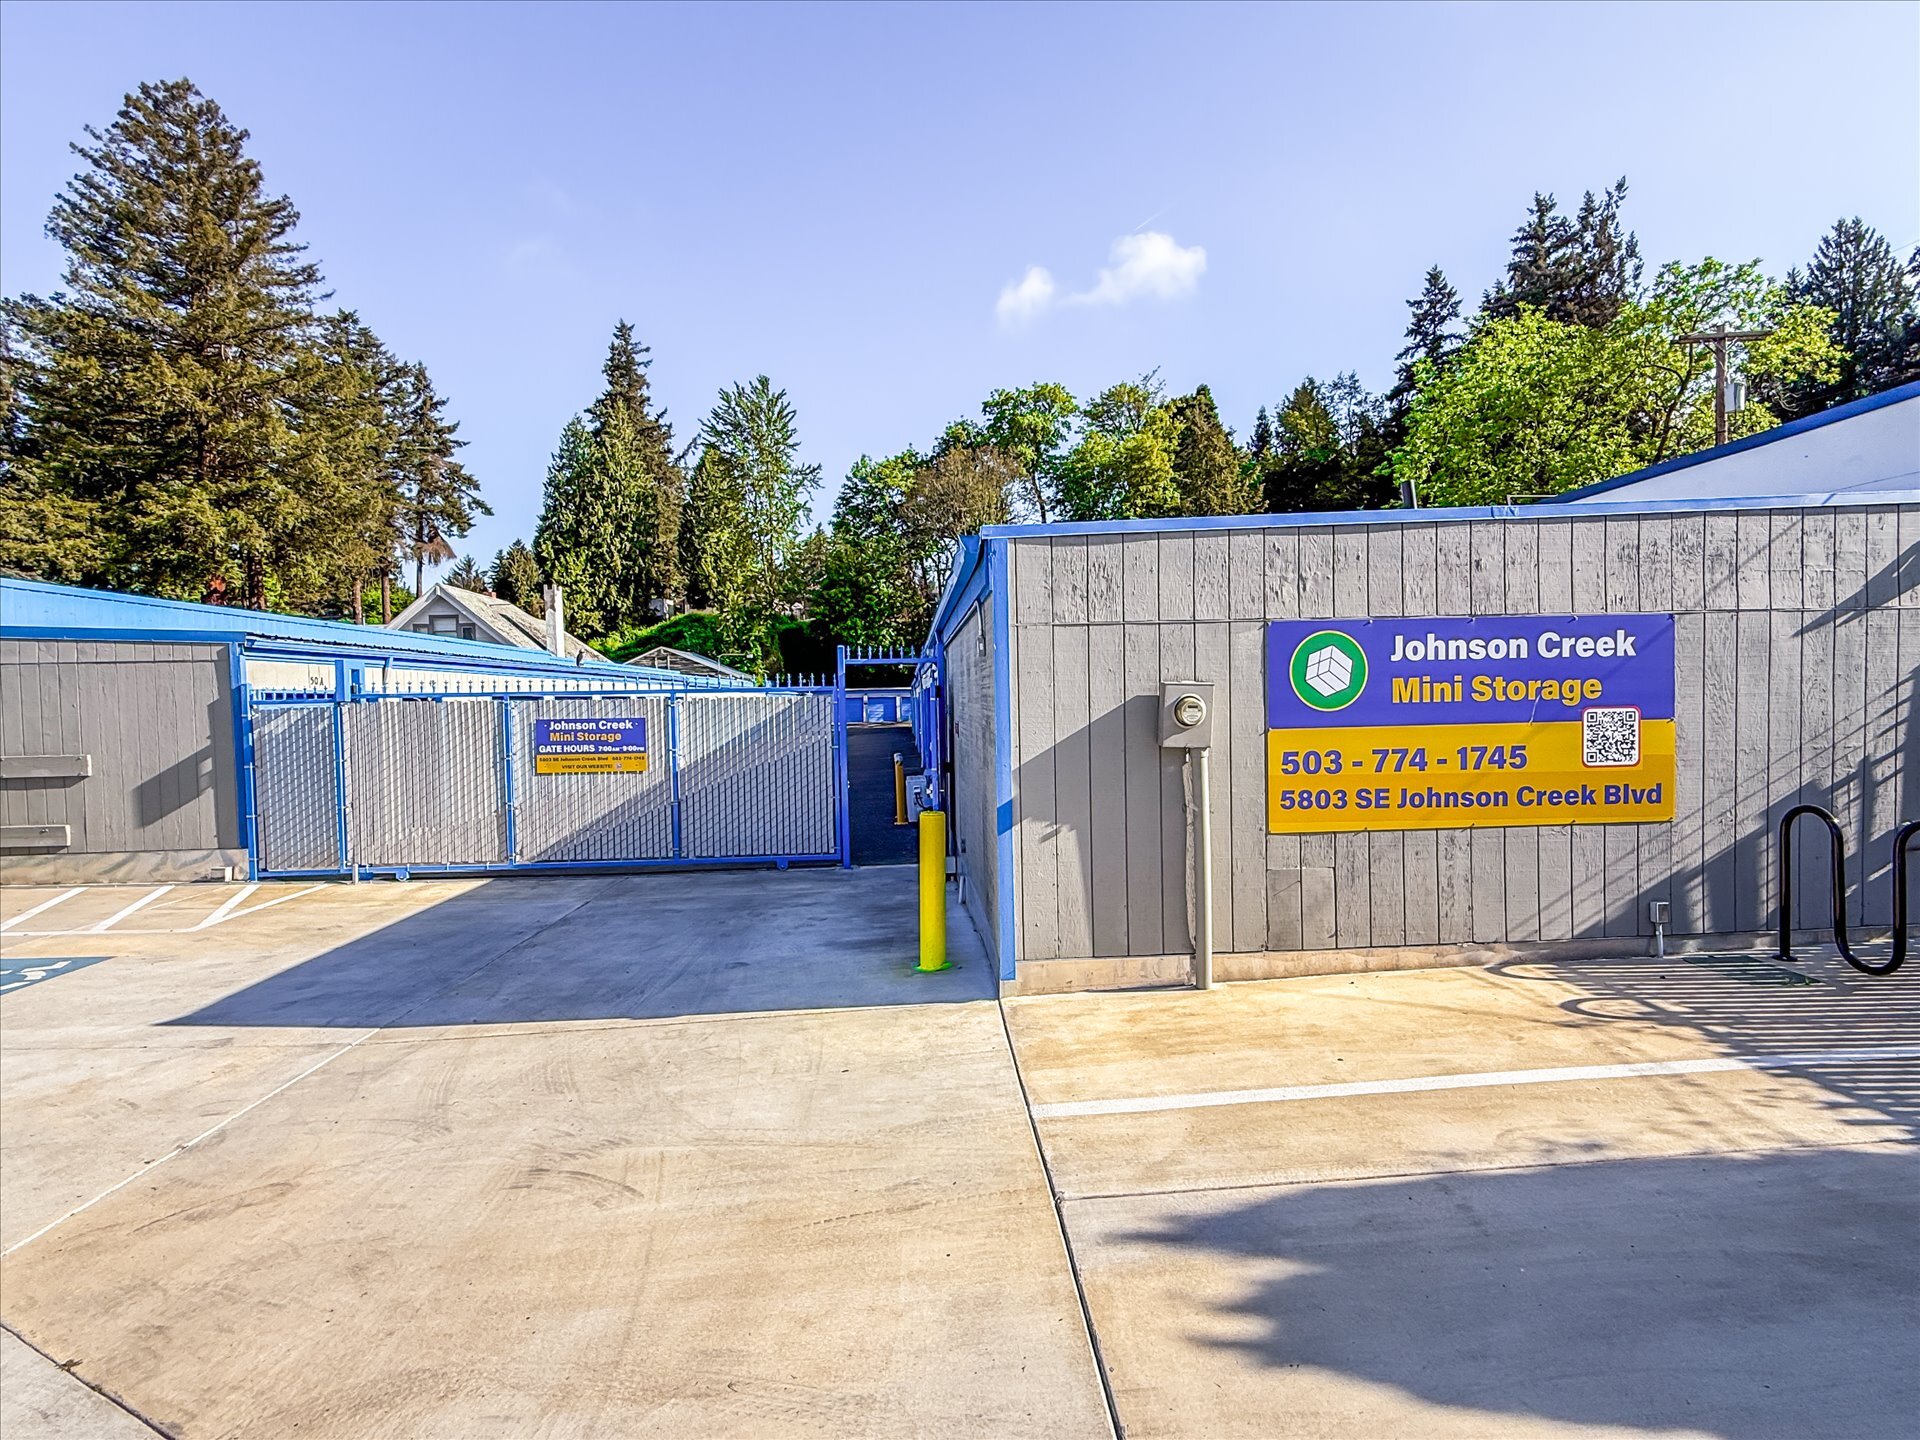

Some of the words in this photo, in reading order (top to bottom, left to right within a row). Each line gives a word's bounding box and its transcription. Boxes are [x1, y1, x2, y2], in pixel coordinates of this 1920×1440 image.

[1391, 633, 1528, 662] Johnson
[1537, 629, 1637, 658] Creek
[1392, 675, 1463, 704] Mini
[1471, 673, 1603, 706] Storage
[549, 721, 596, 730] Johnson
[599, 720, 633, 729] Creek
[550, 732, 574, 741] Mini
[577, 732, 622, 743] Storage
[539, 745, 562, 753] GATE
[1281, 750, 1343, 775] 503
[1371, 748, 1428, 773] 774
[1456, 744, 1528, 771] 1745
[1280, 788, 1348, 810] 5803
[1355, 787, 1391, 809] SE
[1397, 786, 1509, 809] Johnson
[1516, 784, 1597, 807] Creek
[1604, 783, 1663, 806] Blvd
